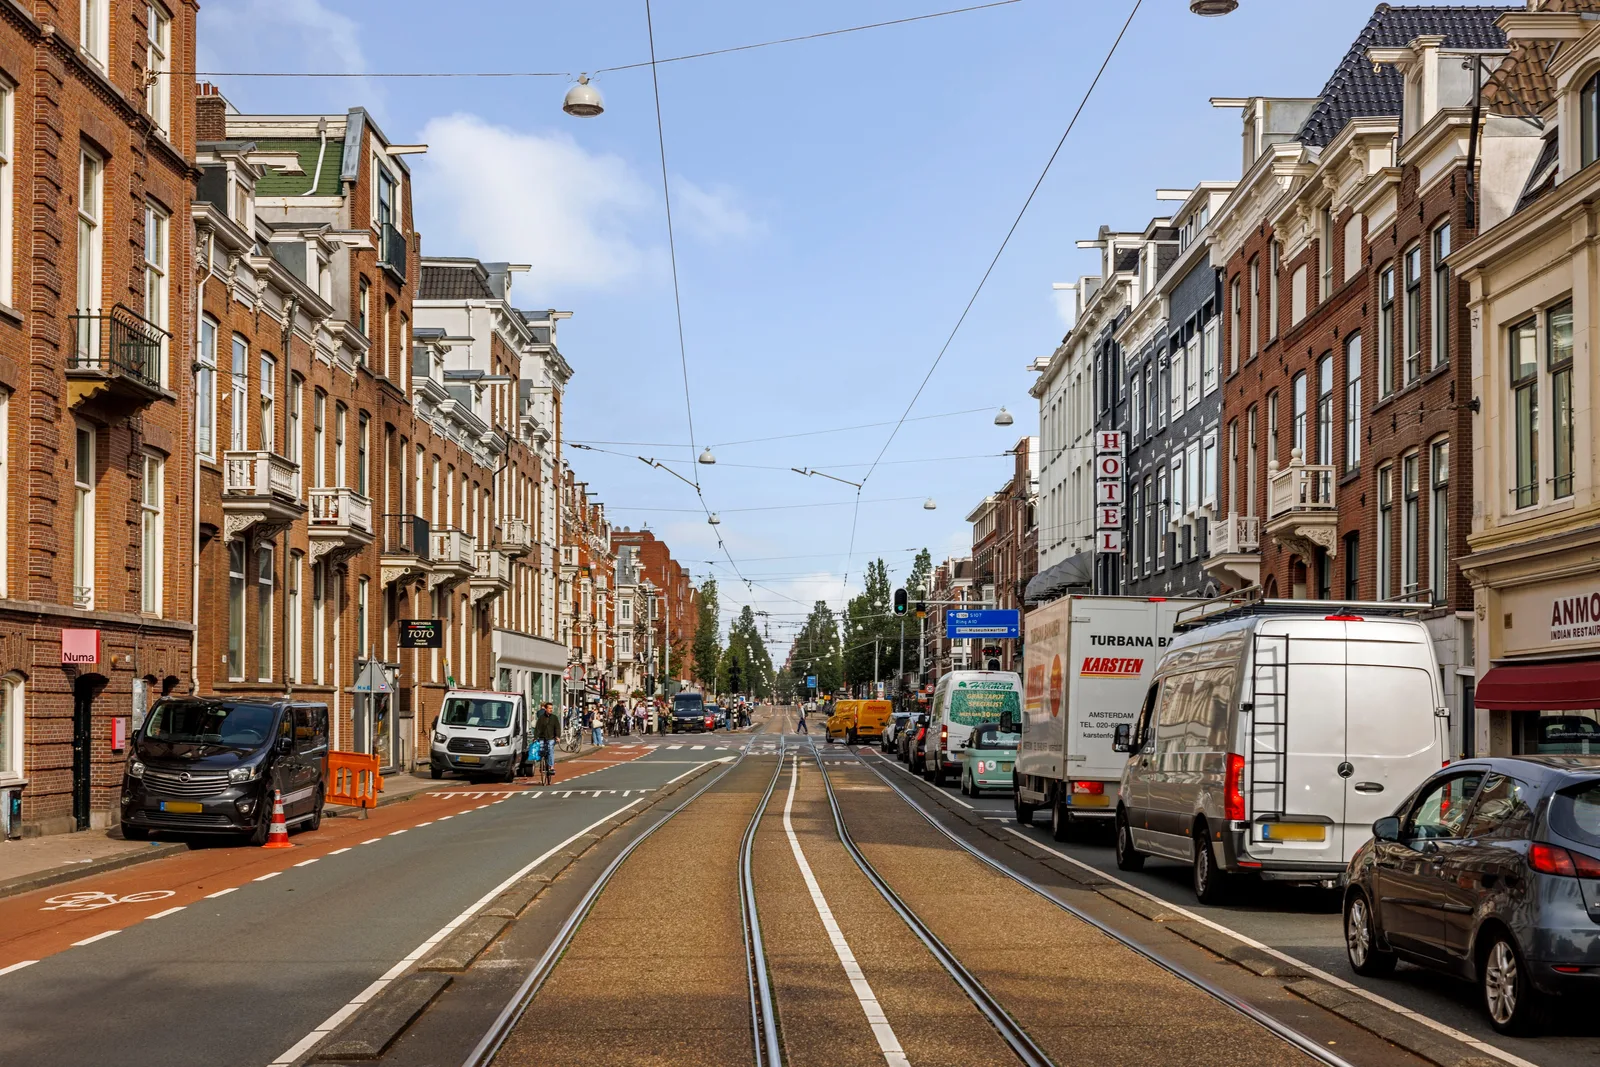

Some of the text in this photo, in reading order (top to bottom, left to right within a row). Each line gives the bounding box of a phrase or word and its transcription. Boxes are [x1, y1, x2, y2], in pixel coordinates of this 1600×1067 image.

[1102, 433, 1119, 549] HOTEL
[1551, 629, 1571, 640] INDIAN
[1090, 635, 1154, 647] TURBANA
[64, 652, 94, 662] Numa
[1082, 657, 1144, 672] KARSTEN
